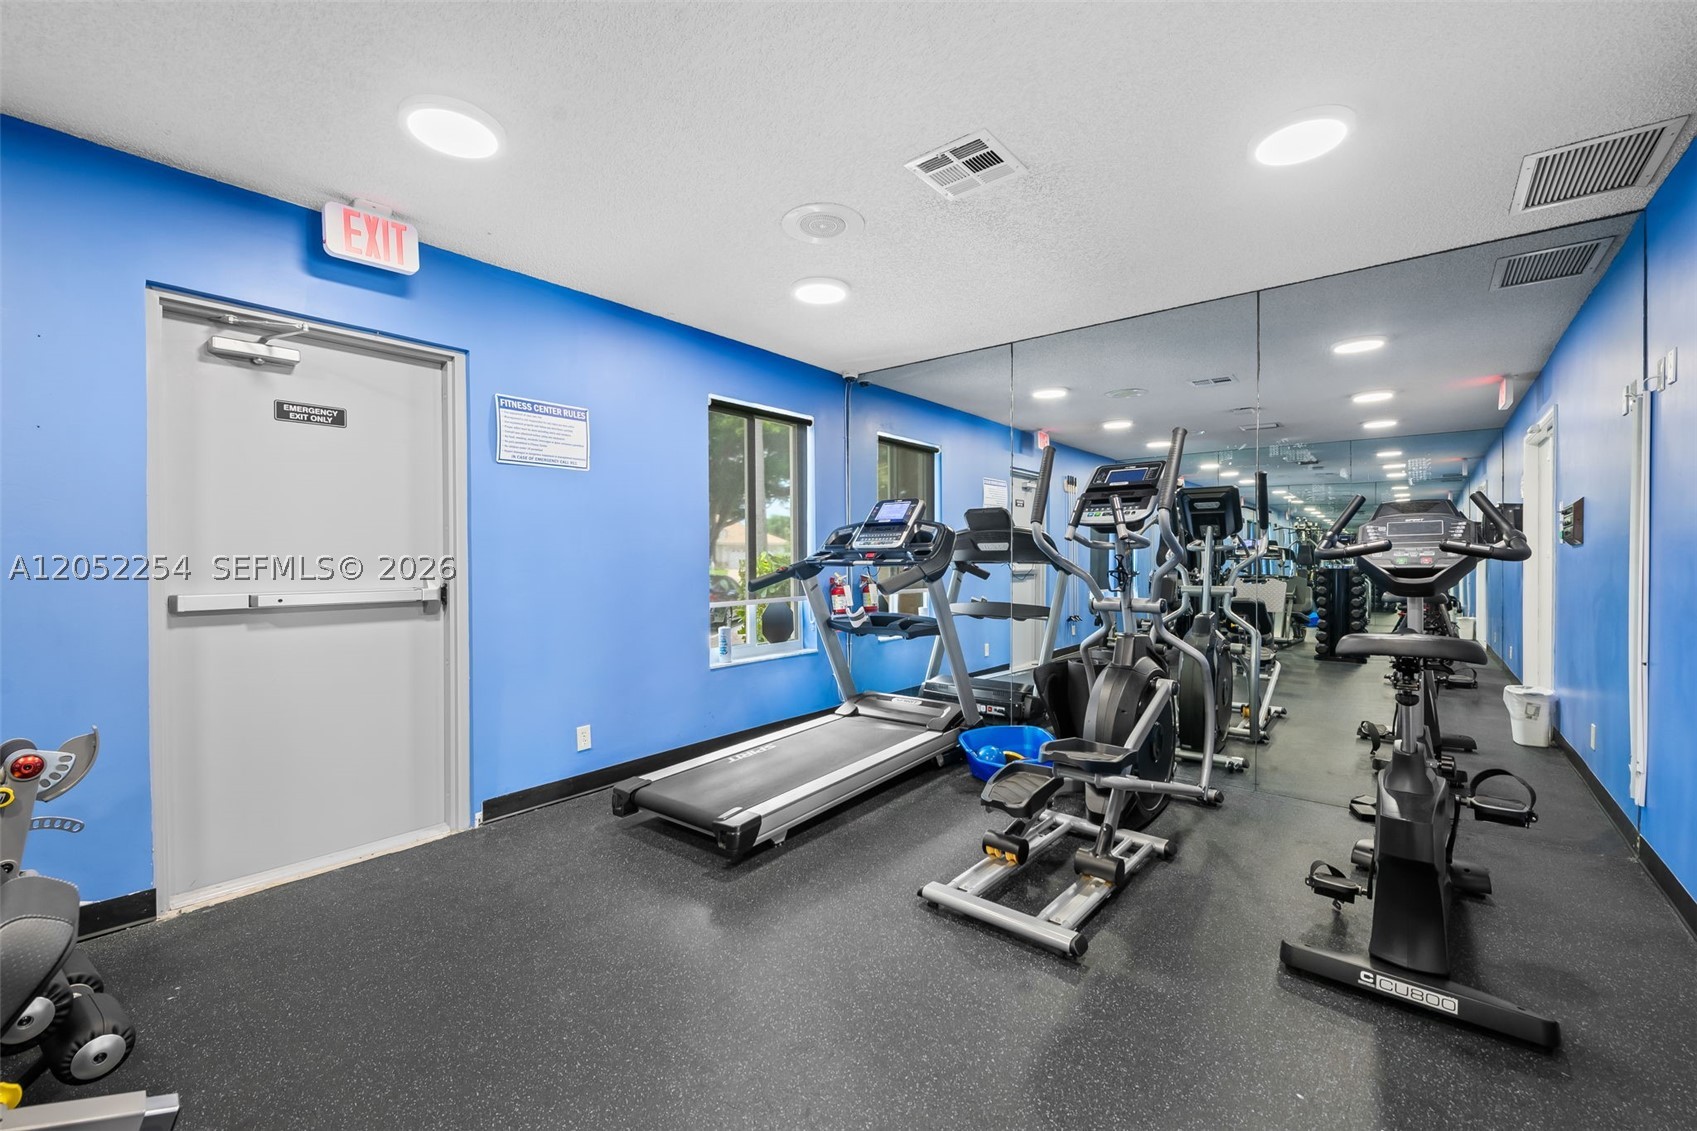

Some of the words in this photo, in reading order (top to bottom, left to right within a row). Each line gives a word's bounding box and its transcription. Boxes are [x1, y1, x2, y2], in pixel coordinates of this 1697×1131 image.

[342, 207, 407, 265] EXIT
[283, 404, 338, 417] EMERGENCY
[289, 412, 308, 420] EXIT
[310, 415, 333, 423] ONLY
[500, 399, 532, 411] FITNESS
[533, 404, 562, 416] CENTER
[563, 409, 586, 420] RULES
[1379, 978, 1457, 1011] CU800
